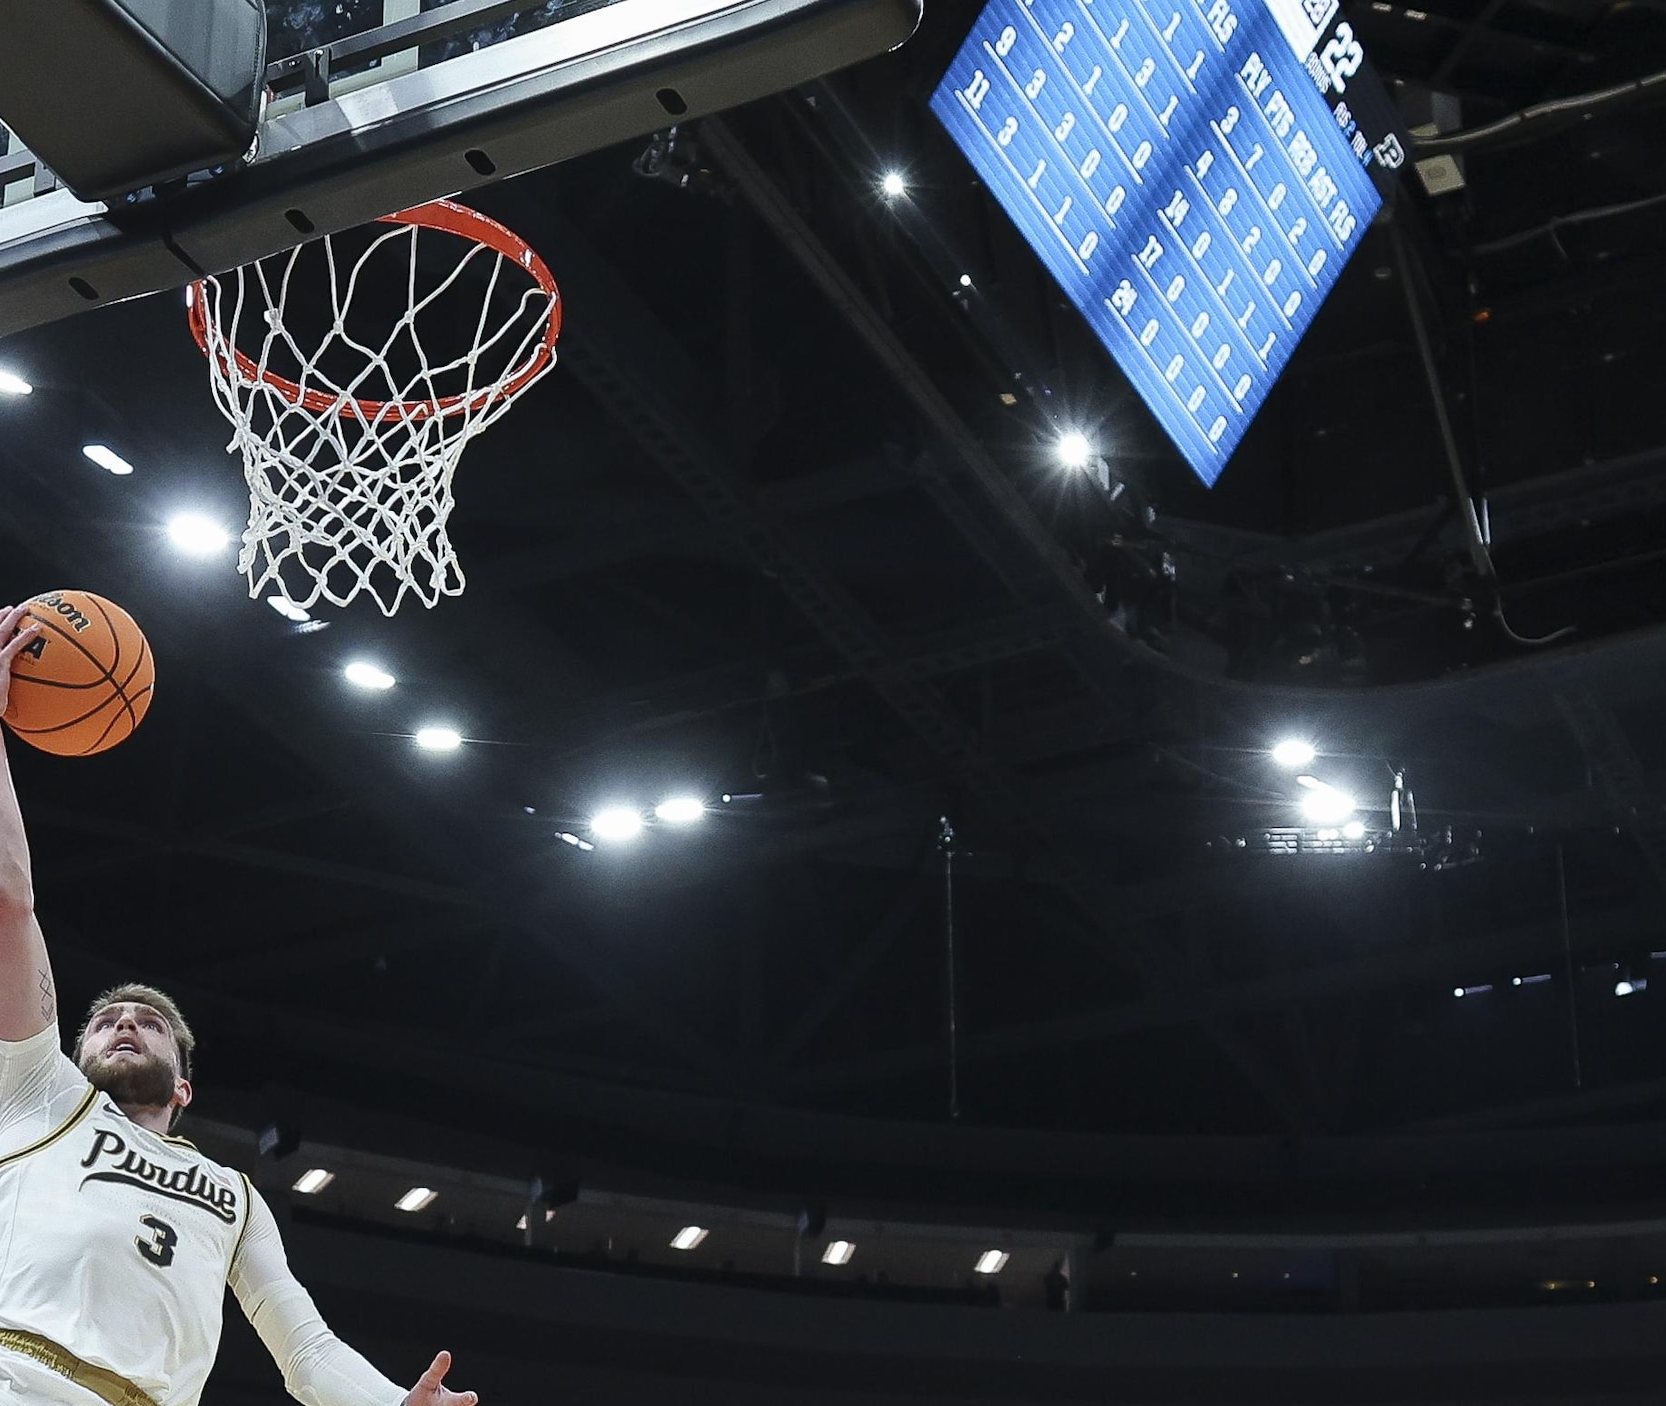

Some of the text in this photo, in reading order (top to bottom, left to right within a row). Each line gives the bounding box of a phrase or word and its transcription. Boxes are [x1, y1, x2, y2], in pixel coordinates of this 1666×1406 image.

[1109, 18, 1130, 50] 1
[1159, 95, 1179, 126] 1
[1162, 12, 1205, 80] 1 1
[1319, 21, 1363, 95] 22
[1052, 22, 1152, 169] 2 1 0 0
[964, 70, 1099, 260] 11 3 1 1 0
[1220, 106, 1239, 134] 3
[1245, 144, 1264, 170] 7
[1287, 217, 1307, 245] 2
[1241, 226, 1261, 254] 2
[1216, 268, 1235, 297] 1
[1237, 301, 1256, 330] 1
[1258, 331, 1276, 360] 1
[79, 1126, 237, 1225] Purdue
[133, 1213, 179, 1268] 3
